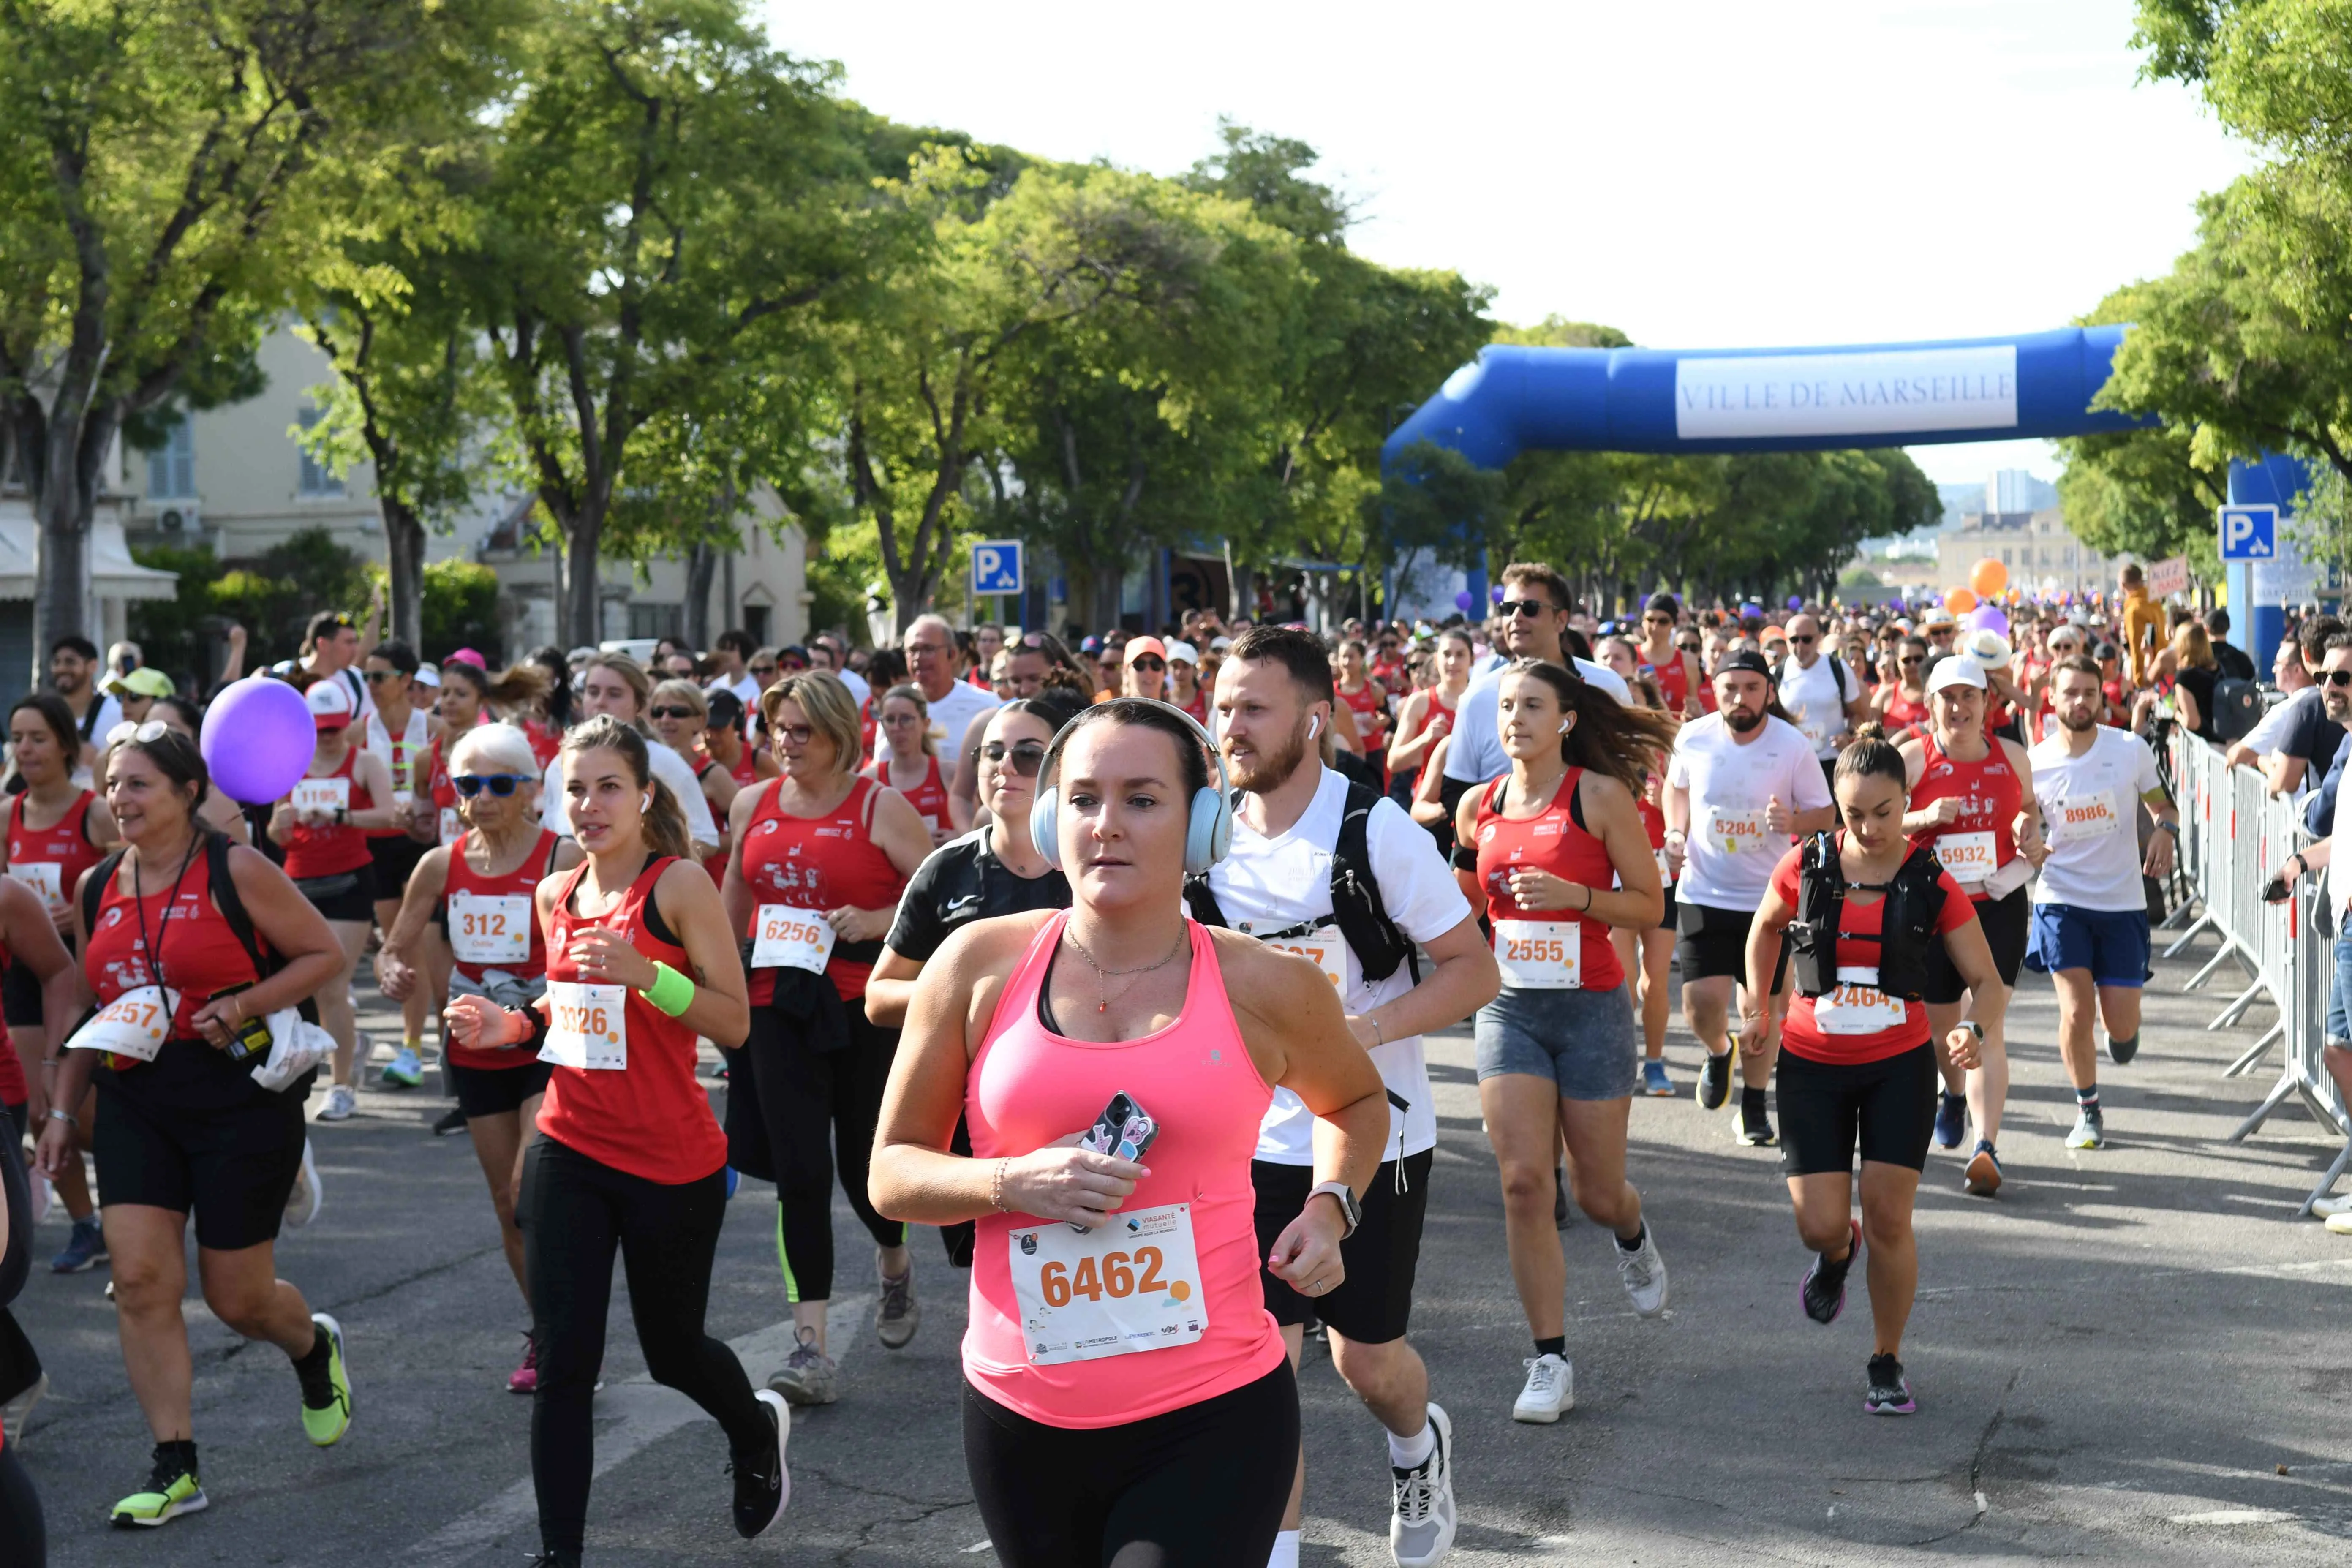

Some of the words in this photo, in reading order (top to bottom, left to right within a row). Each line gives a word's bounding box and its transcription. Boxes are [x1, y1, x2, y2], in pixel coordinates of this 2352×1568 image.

[1682, 381, 1779, 410] VILLE
[1790, 380, 1829, 408] DE
[1840, 373, 2012, 406] MARSEILLE
[2227, 513, 2254, 552] P
[977, 549, 1001, 583] P
[2065, 803, 2107, 823] 8986
[1715, 819, 1756, 836] 5284
[1941, 846, 1986, 864] 5932
[463, 913, 506, 936] 312
[766, 920, 821, 944] 6256
[1507, 939, 1564, 962] 2555
[1832, 985, 1890, 1007] 2464
[560, 1005, 607, 1035] 3326
[1142, 1211, 1176, 1224] VIASANTÉ
[1143, 1220, 1176, 1230] mutuelle
[1041, 1246, 1168, 1307] 6462
